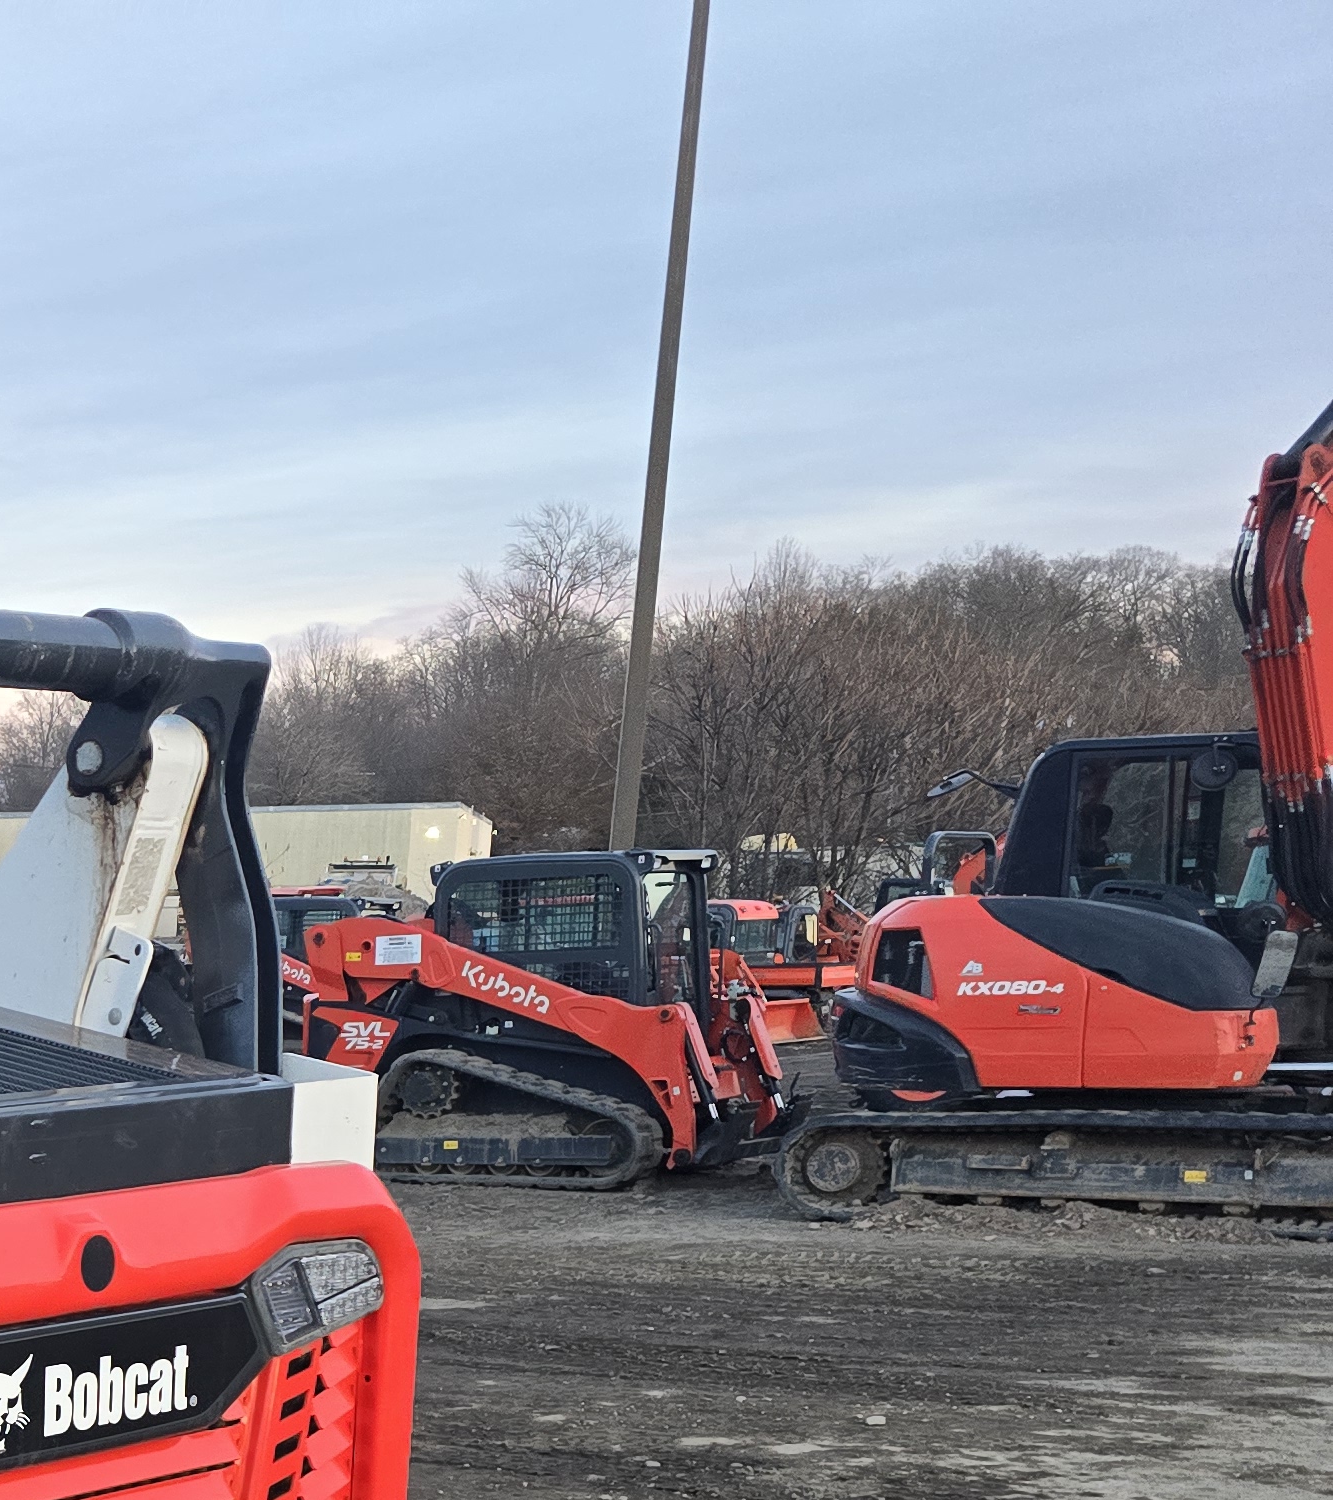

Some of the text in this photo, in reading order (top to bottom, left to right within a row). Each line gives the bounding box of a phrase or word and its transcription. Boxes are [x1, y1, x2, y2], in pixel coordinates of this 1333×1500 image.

[282, 960, 311, 985] bota
[461, 960, 550, 1014] Kubota
[956, 980, 1065, 996] KX080-4
[340, 1021, 391, 1037] SVL
[344, 1037, 384, 1050] 75-2
[43, 1344, 190, 1438] Bobcat
